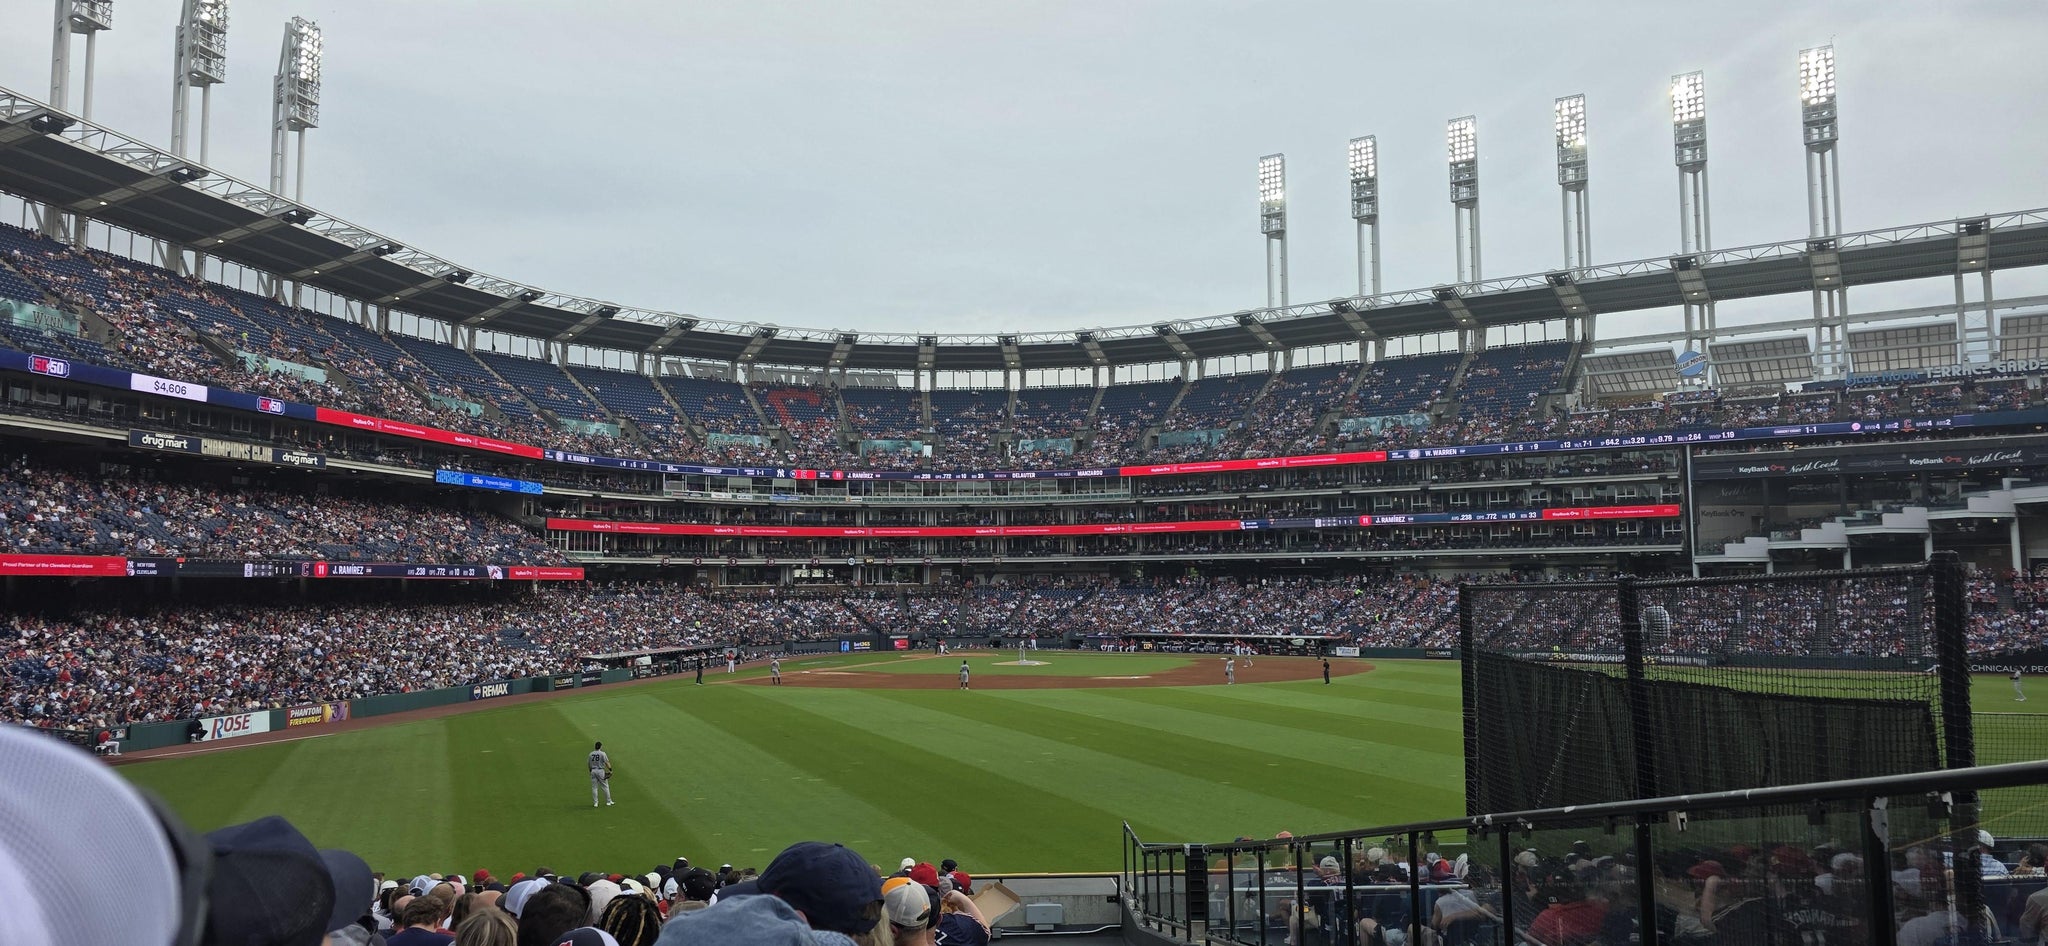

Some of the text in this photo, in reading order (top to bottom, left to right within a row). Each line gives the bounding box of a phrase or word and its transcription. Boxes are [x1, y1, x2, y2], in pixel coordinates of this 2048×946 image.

[33, 311, 64, 328] WYNN
[1882, 371, 1919, 381] MOON
[1924, 364, 1991, 379] TERRACE
[154, 380, 187, 395] $4,606
[141, 434, 188, 449] drug mart
[1722, 431, 1735, 439] 1.19
[201, 438, 273, 462] CHAMPIONS CLUB
[282, 451, 318, 466] drug mart
[1909, 457, 1944, 466] KeyBank
[1964, 450, 2022, 466] North Coast
[1739, 466, 1769, 474] KeyBank
[1786, 459, 1839, 475] North Coast
[1381, 515, 1405, 523] RAMÍREZ
[318, 565, 325, 574] 11
[332, 563, 364, 575] J. RAMÍREZ
[414, 568, 425, 576] .238
[436, 568, 445, 576] .772
[454, 568, 460, 576] 10
[290, 705, 322, 718] PHANTOM
[211, 714, 250, 740] ROSE
[289, 714, 322, 727] FIREWORKS
[591, 754, 600, 762] 78
